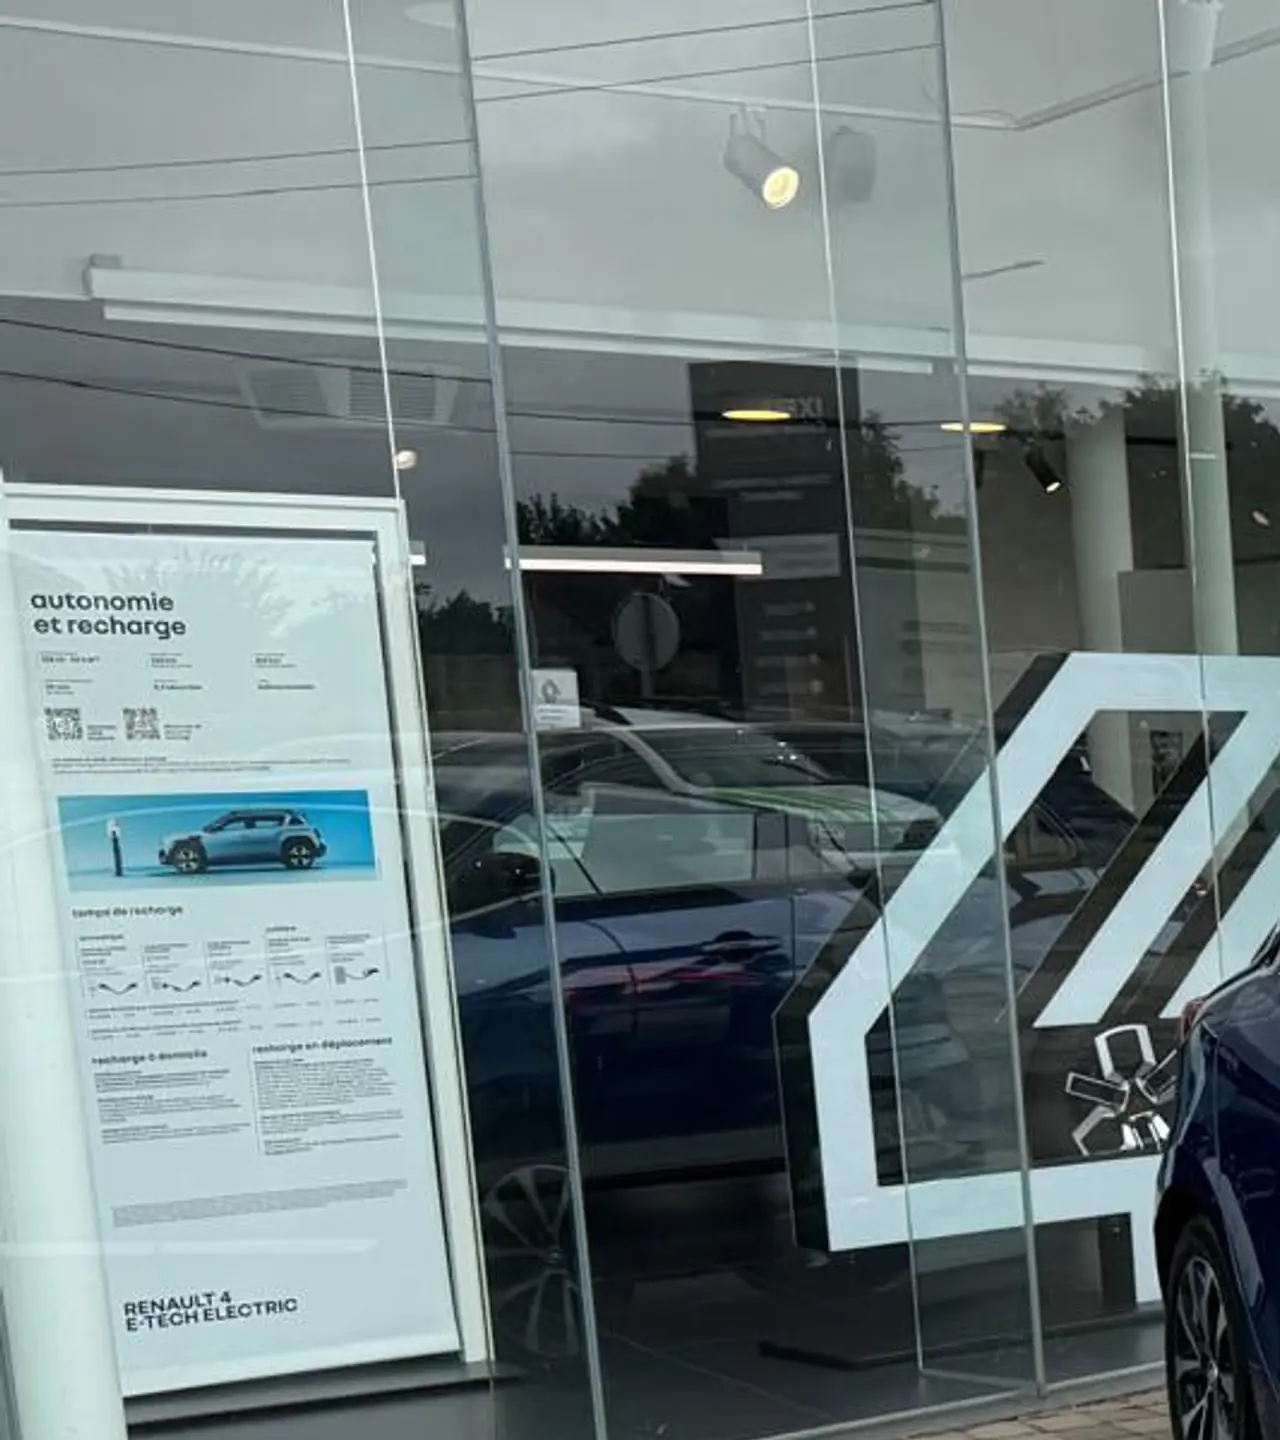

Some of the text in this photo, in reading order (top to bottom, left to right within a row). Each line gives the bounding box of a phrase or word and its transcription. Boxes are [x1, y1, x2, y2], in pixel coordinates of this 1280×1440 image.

[30, 591, 175, 612] autonomie
[33, 615, 187, 640] et recharge
[124, 1291, 232, 1316] RENAULT 4
[126, 1298, 299, 1332] E-TECH ELECTRIC
